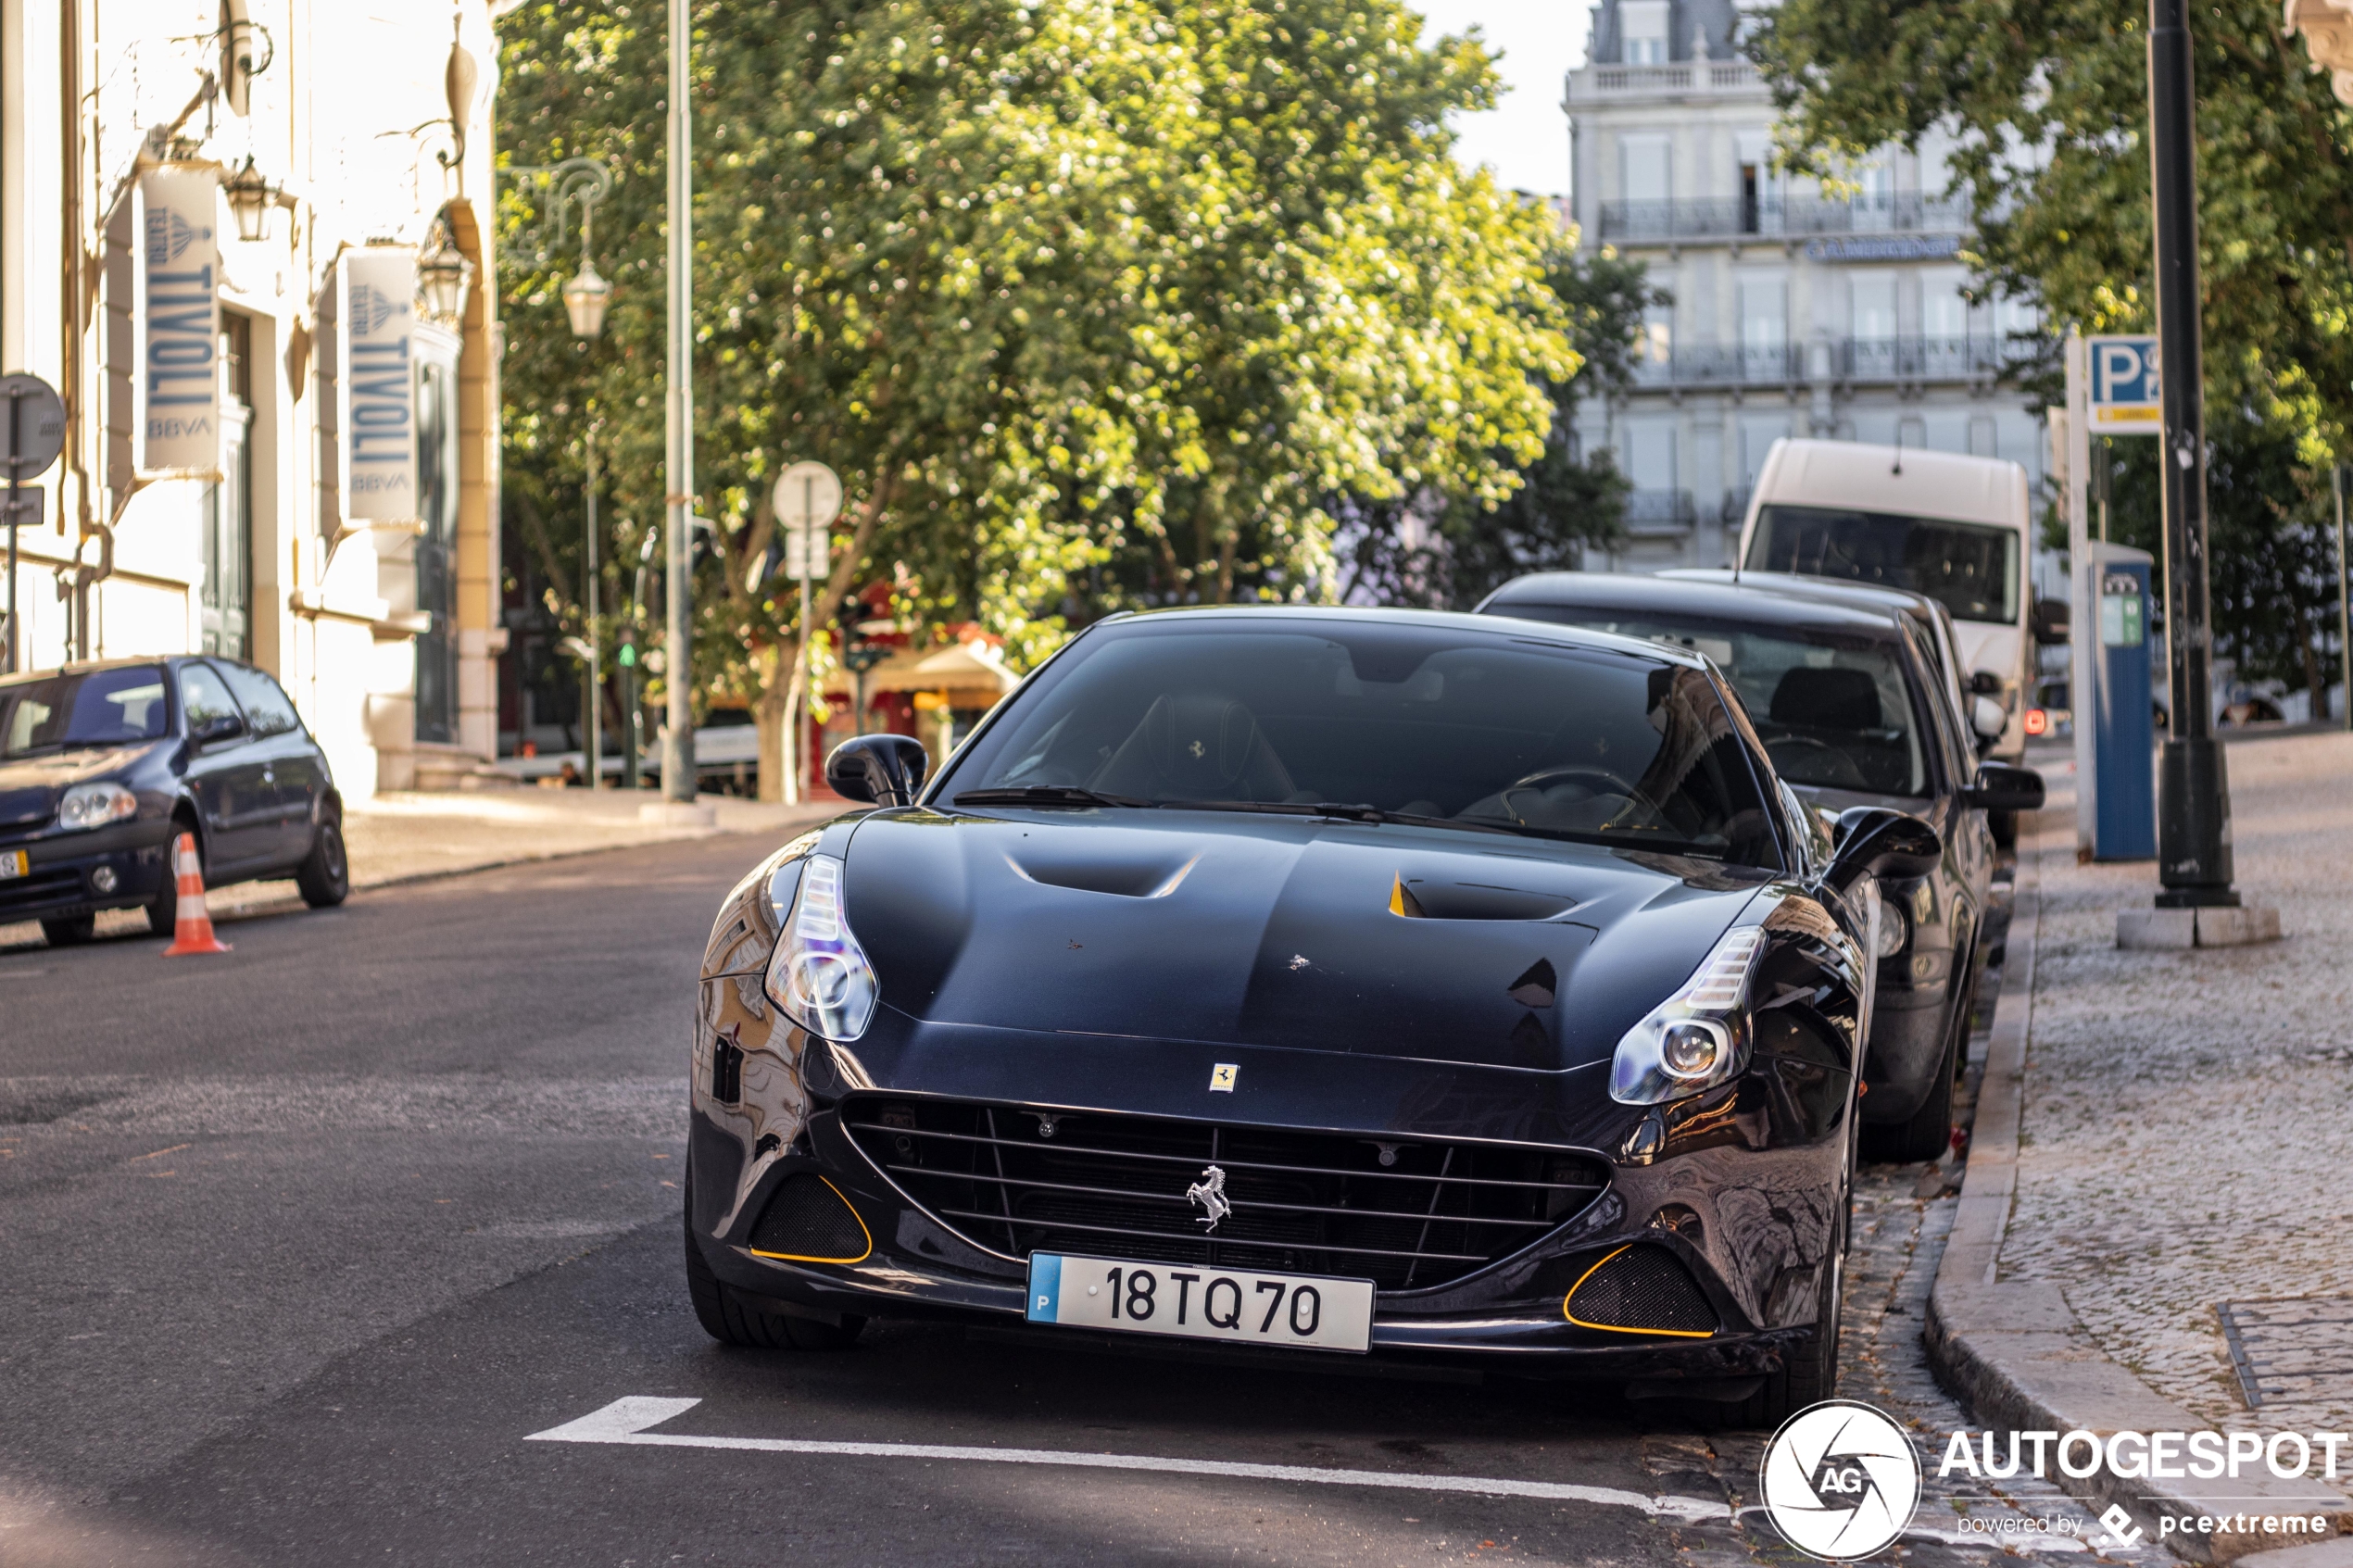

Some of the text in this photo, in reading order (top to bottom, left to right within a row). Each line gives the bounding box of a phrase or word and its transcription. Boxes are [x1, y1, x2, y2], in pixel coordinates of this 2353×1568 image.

[147, 207, 168, 264] TEATRO
[148, 264, 212, 405] TIVOLI
[350, 284, 370, 335] TEATRO
[352, 335, 409, 462] TIVOLI
[2100, 345, 2142, 402] P
[147, 416, 212, 440] BBVA
[351, 471, 409, 493] BBVA
[1037, 1295, 1050, 1311] P
